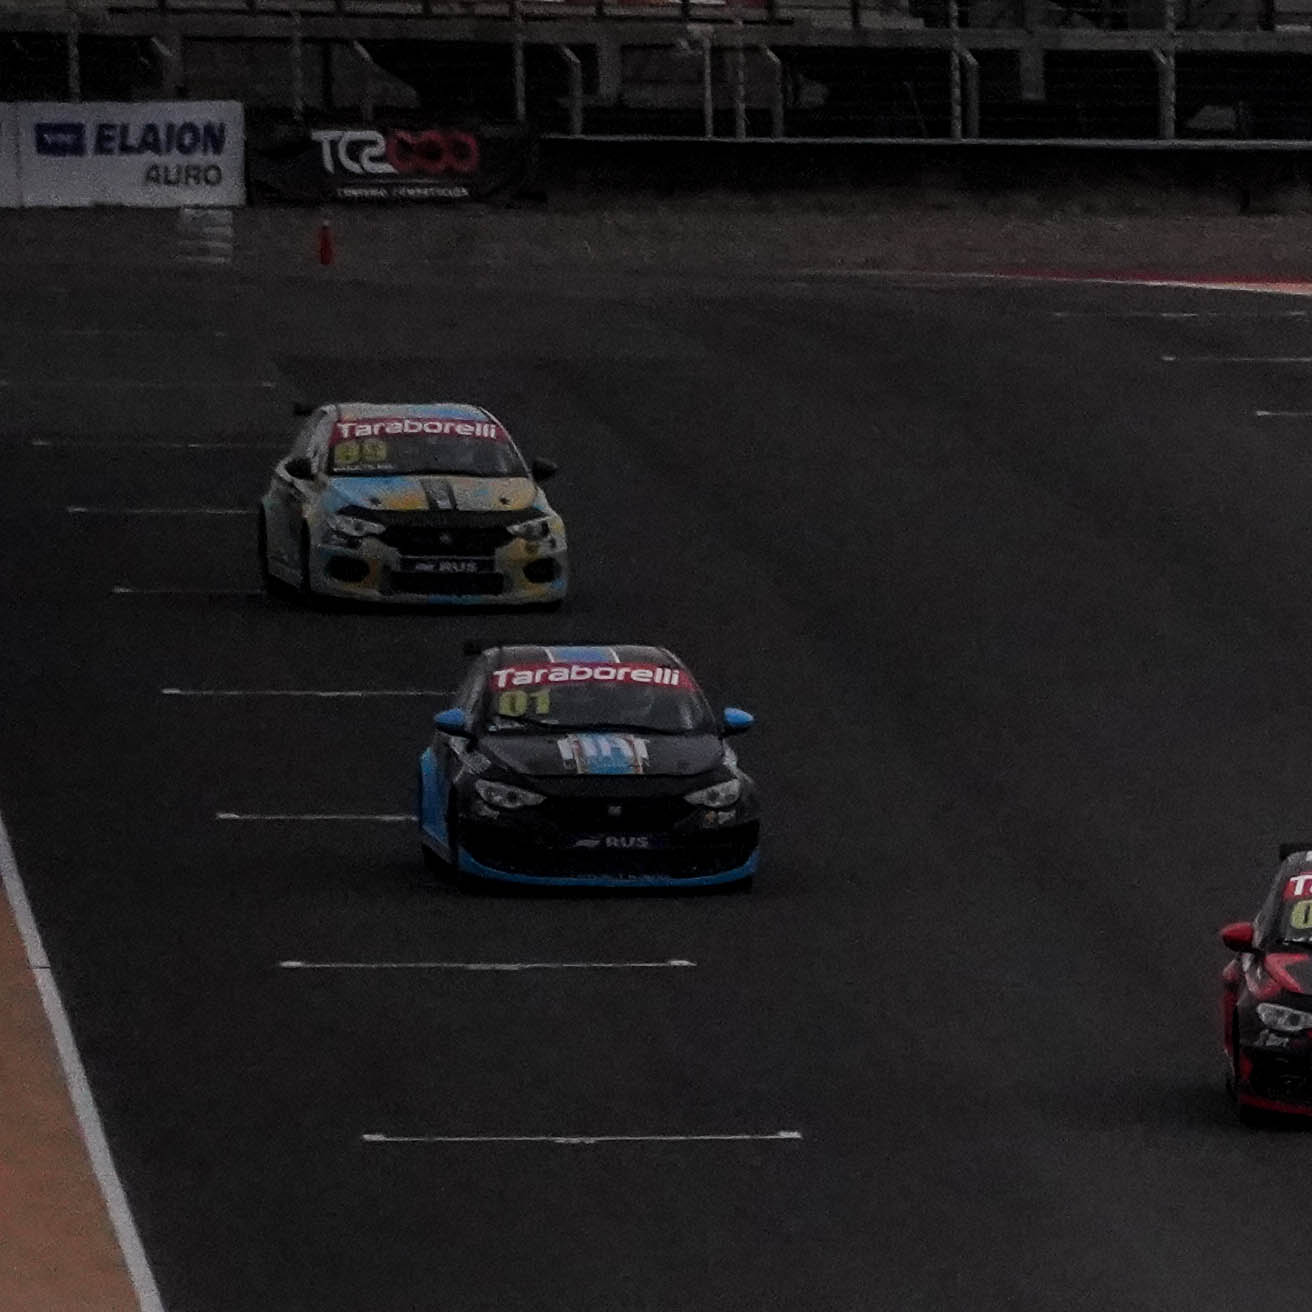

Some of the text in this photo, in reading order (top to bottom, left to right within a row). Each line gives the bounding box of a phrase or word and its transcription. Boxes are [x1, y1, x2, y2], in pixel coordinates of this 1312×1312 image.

[94, 122, 226, 155] ELAION
[145, 164, 222, 186] AURO
[336, 419, 498, 440] Taraborelli
[493, 665, 681, 688] Taraborelli
[498, 690, 550, 717] 01
[605, 835, 648, 849] RUS
